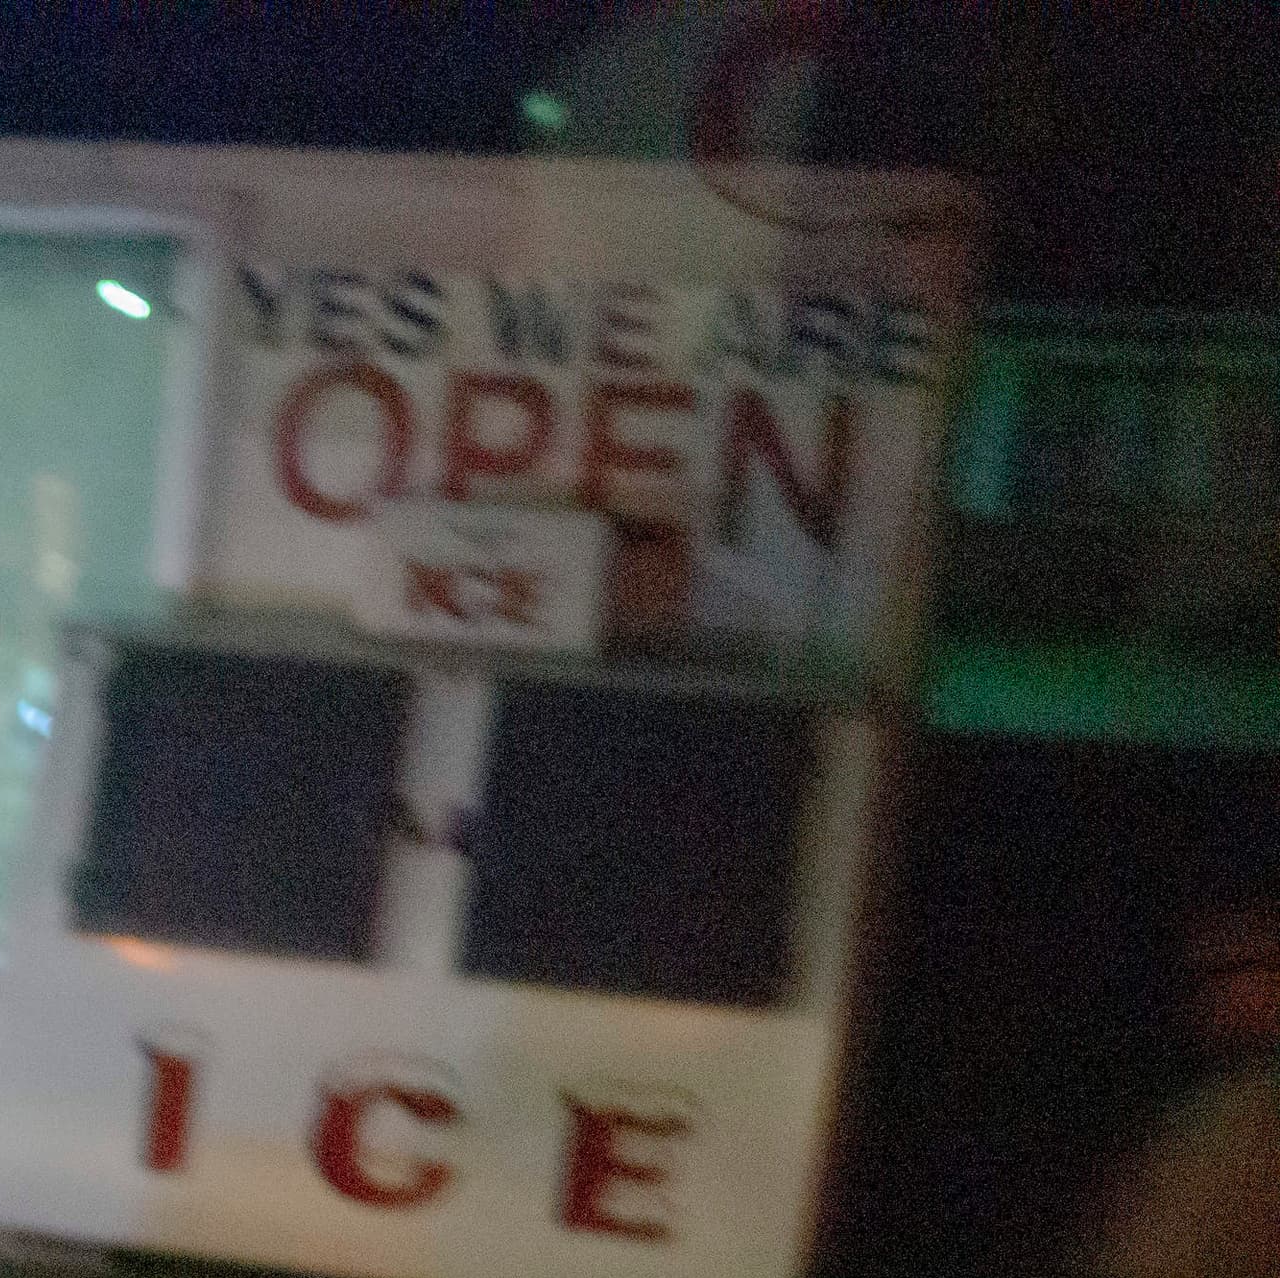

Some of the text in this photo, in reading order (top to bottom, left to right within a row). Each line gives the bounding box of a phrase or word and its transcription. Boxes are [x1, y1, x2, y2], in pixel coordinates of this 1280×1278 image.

[237, 262, 933, 386] YES WE ARE
[272, 357, 860, 550] OPEN
[137, 1042, 692, 1245] ICE
